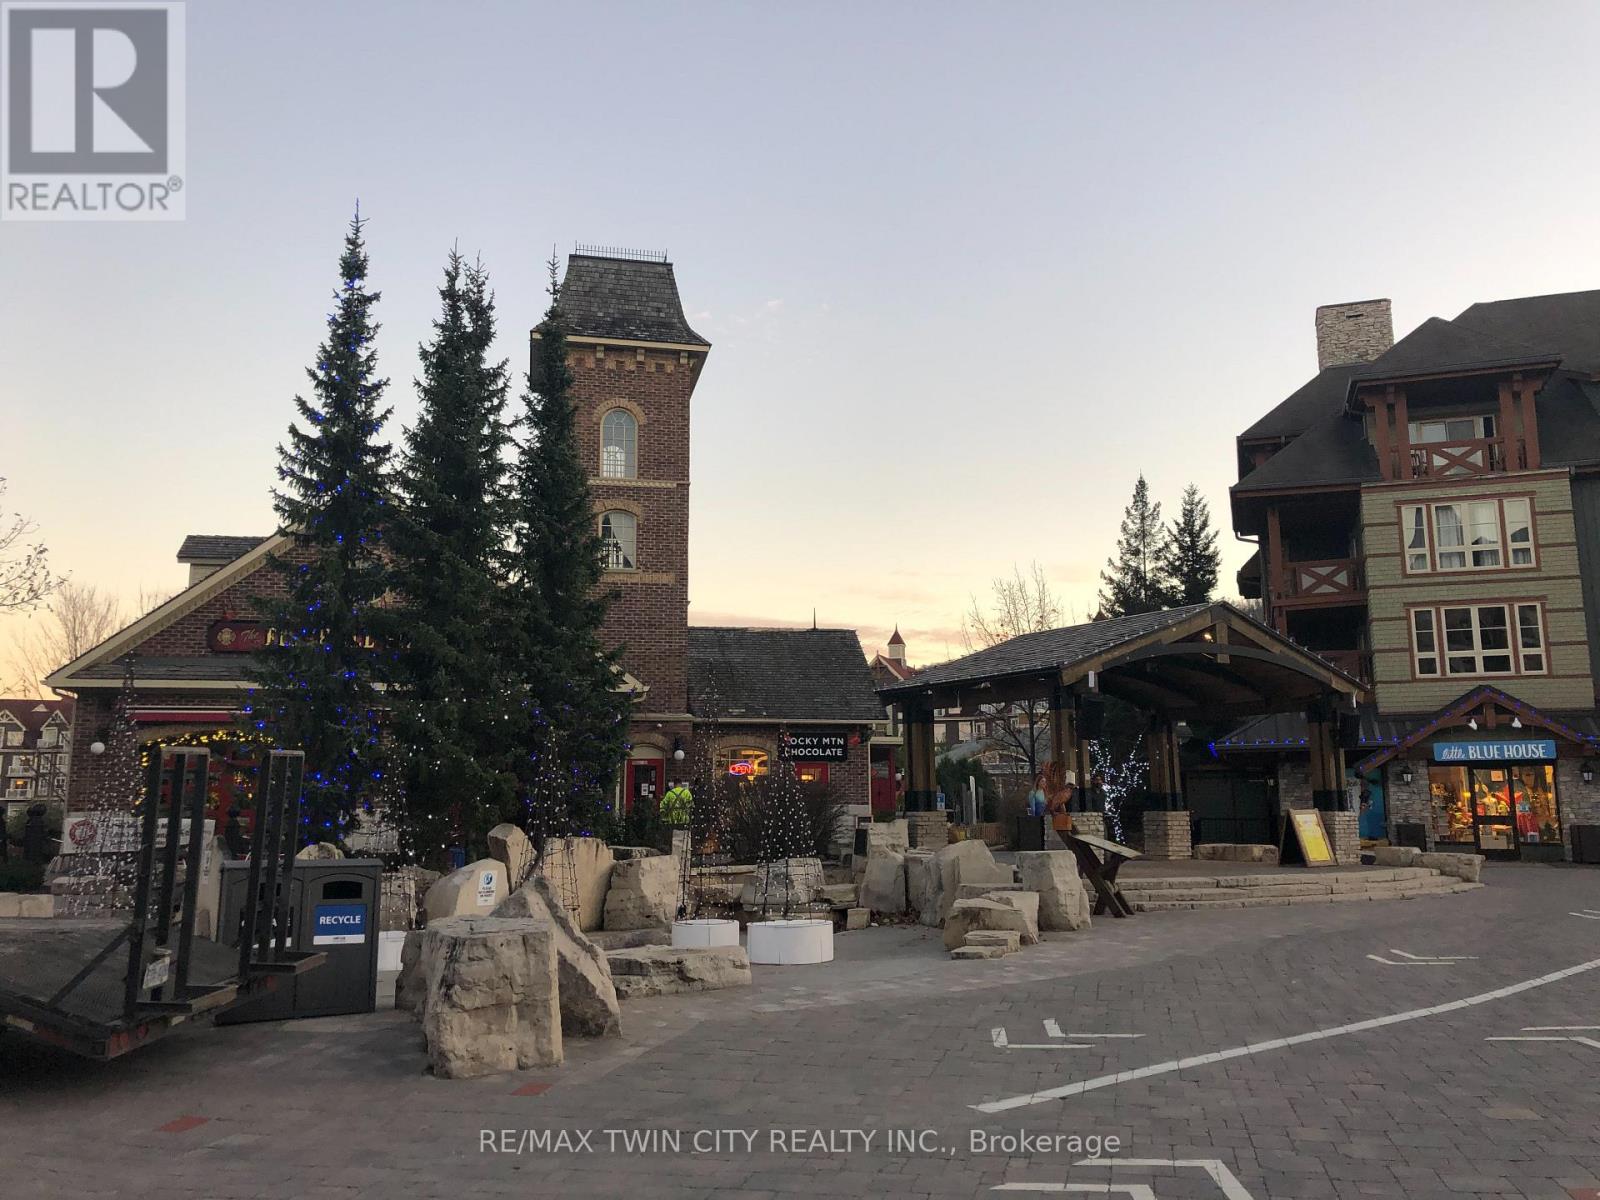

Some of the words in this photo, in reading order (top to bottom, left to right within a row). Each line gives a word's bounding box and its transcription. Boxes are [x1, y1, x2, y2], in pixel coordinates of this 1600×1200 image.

[822, 736, 844, 746] MTN
[1468, 744, 1501, 759] BLUE
[1503, 743, 1547, 758] HOUSE
[731, 765, 753, 774] OPEN
[319, 915, 362, 925] RECYCLE
